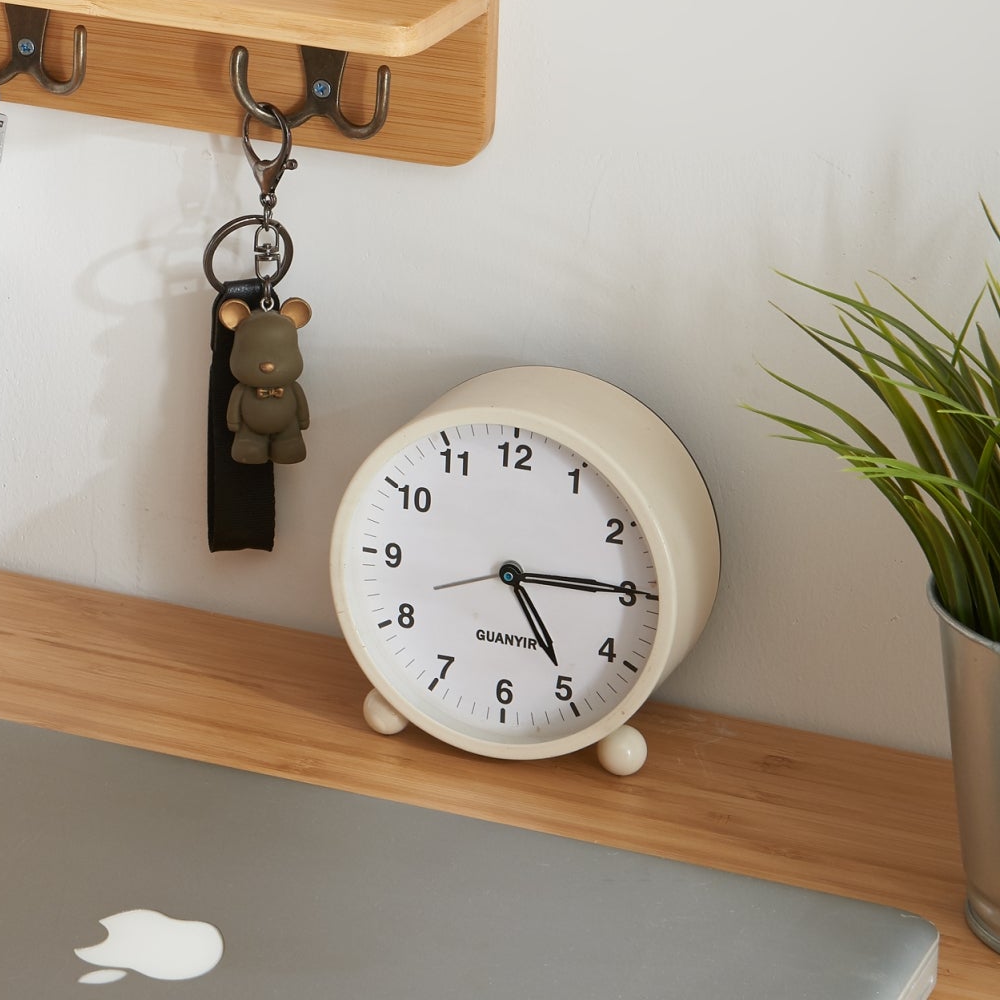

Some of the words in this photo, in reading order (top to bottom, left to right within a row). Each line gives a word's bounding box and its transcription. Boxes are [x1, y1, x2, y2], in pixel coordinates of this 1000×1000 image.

[440, 448, 469, 476] 11
[498, 441, 533, 471] 12
[568, 468, 580, 494] 1
[399, 484, 431, 512] 10
[605, 518, 624, 545] 2
[384, 542, 402, 568] 9
[619, 581, 637, 607] 3
[397, 603, 415, 629] 8
[598, 637, 617, 663] 4
[437, 654, 455, 679] 7
[496, 679, 513, 704] 6
[555, 675, 573, 701] 5
